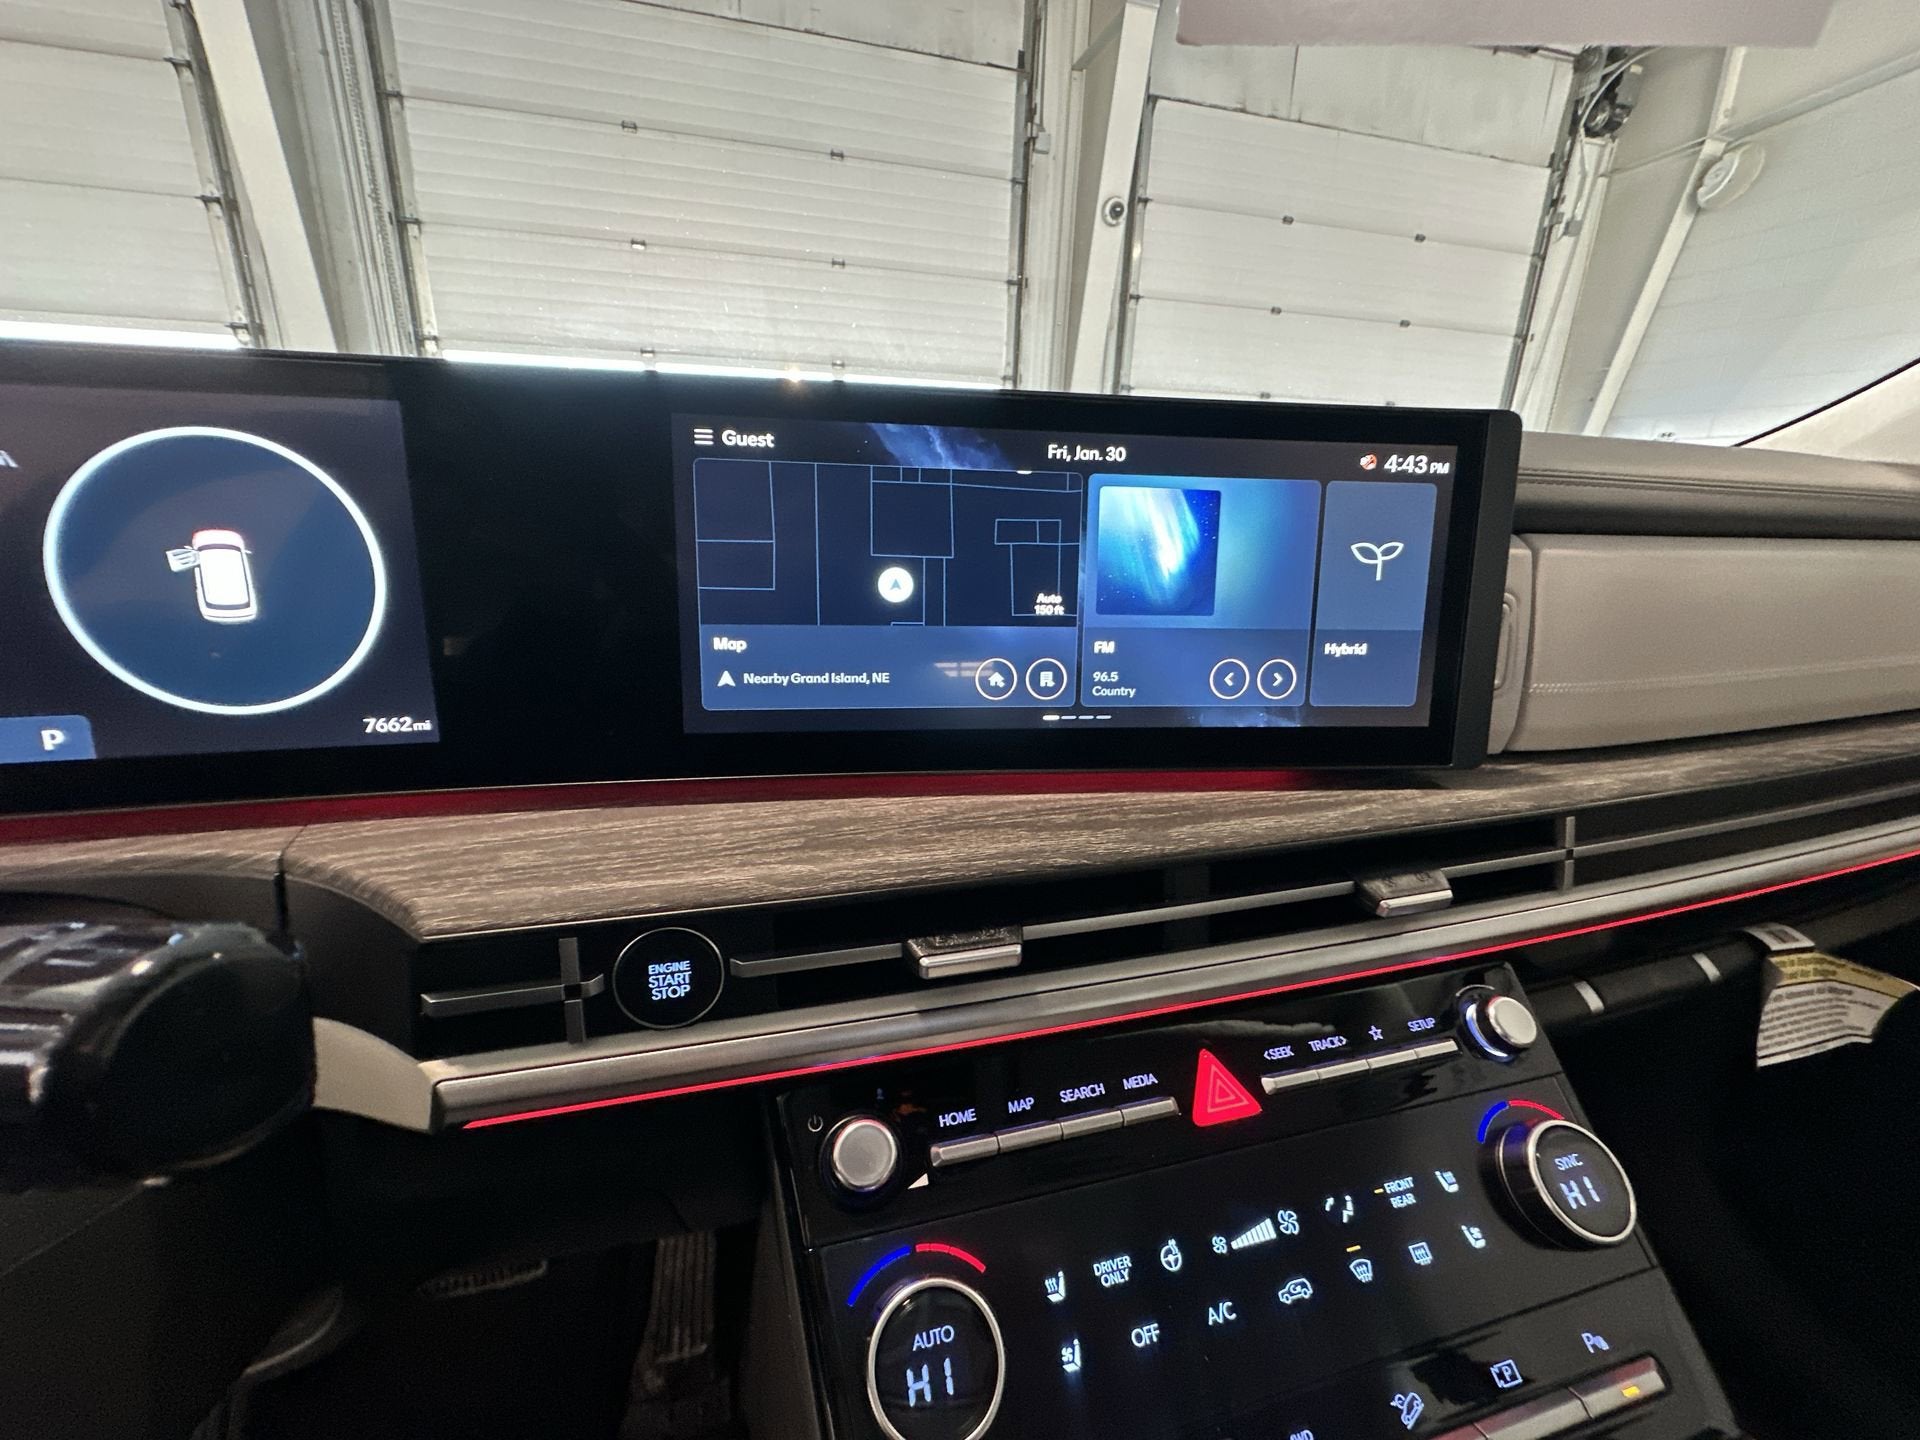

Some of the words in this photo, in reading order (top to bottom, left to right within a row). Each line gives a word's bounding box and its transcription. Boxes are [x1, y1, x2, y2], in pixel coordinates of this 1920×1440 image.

[721, 429, 775, 448] Guest
[1047, 444, 1072, 463] Fri,
[1072, 445, 1104, 462] Jan.
[1105, 446, 1127, 462] 30
[1383, 454, 1428, 475] 4:43
[1429, 462, 1450, 474] PM
[1036, 593, 1063, 605] Auto
[1033, 604, 1053, 616] 150
[1053, 604, 1065, 616] ft
[713, 637, 748, 655] Map
[1093, 640, 1115, 654] FM
[1324, 642, 1368, 657] Hybrid
[743, 672, 789, 688] Nearby
[790, 672, 829, 684] Grand
[830, 672, 869, 685] Island,
[871, 672, 890, 684] NE
[1092, 671, 1119, 682] 96.5
[1092, 685, 1137, 699] Country
[41, 729, 66, 751] P
[648, 960, 691, 975] ENGINE
[648, 971, 692, 989] START
[651, 984, 691, 1001] STOP
[1407, 1017, 1436, 1033] SETUP
[1122, 1072, 1159, 1090] MEDIA
[1059, 1082, 1106, 1103] SEARCH
[1007, 1096, 1035, 1114] MAP
[938, 1108, 977, 1128] HOME
[1554, 1153, 1584, 1171] SYNC
[1383, 1176, 1414, 1194] FRONT
[1559, 1175, 1601, 1210] HI
[1390, 1192, 1416, 1209] REAR
[1092, 1255, 1133, 1276] DRIVER
[1100, 1270, 1130, 1288] ONLY
[1208, 1301, 1237, 1326] A/C
[912, 1324, 955, 1352] AUTO
[1131, 1322, 1160, 1348] OFF
[906, 1356, 954, 1408] HI
